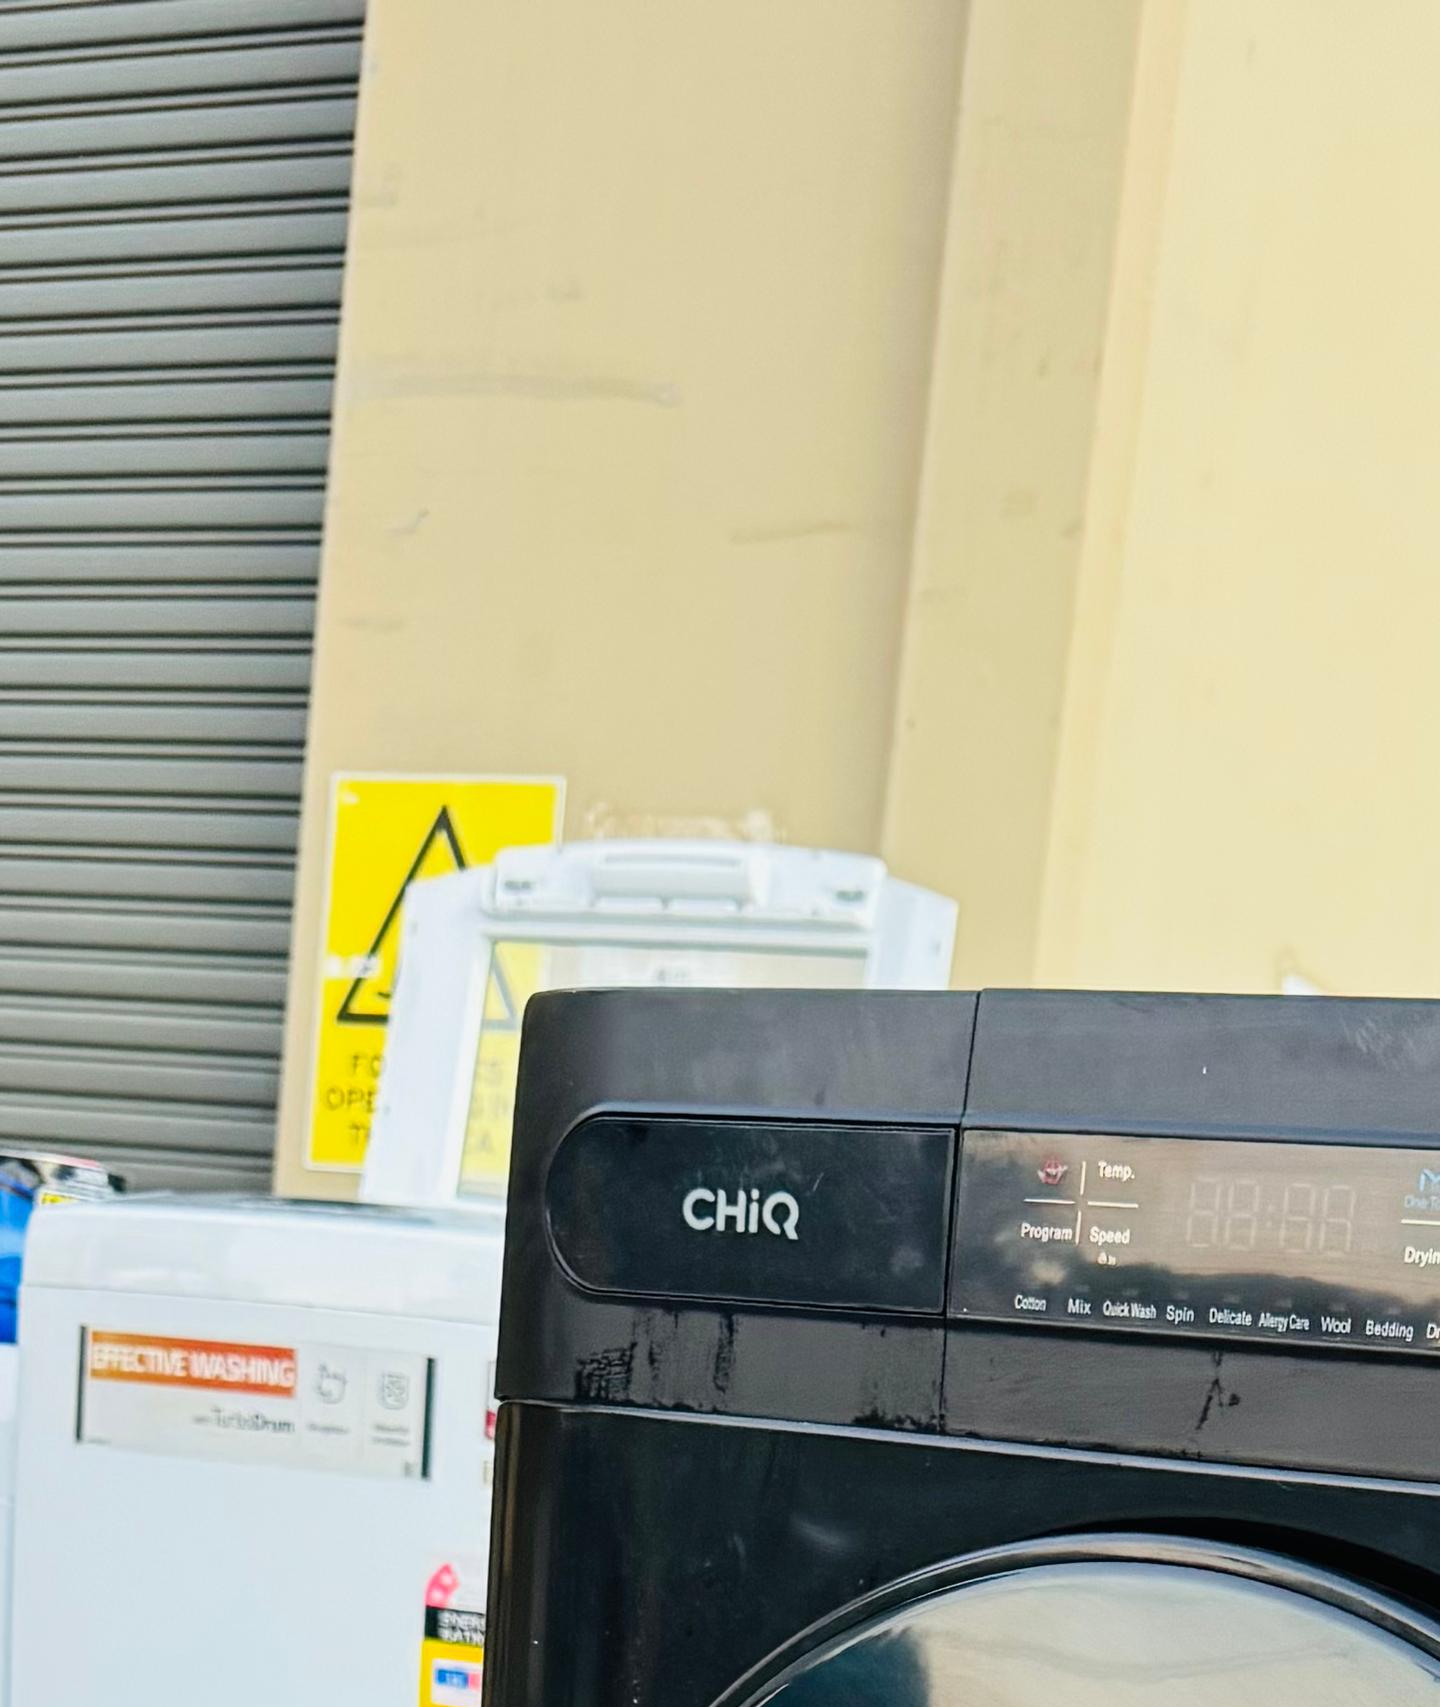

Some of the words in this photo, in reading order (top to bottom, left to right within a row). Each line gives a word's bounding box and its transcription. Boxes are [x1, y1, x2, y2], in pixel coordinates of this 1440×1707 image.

[1097, 1161, 1136, 1182] Temp.
[1020, 1222, 1073, 1243] Program
[1089, 1225, 1131, 1246] Speed
[1014, 1294, 1047, 1312] Cotton
[1067, 1297, 1092, 1316] Mix
[1103, 1300, 1130, 1319] Quick
[1130, 1302, 1157, 1320] Wash
[1166, 1305, 1195, 1325] Spin
[1209, 1307, 1252, 1328] Delicate
[1258, 1314, 1289, 1333] Allergy
[1289, 1315, 1310, 1332] Care
[1320, 1315, 1353, 1335] Wool
[1365, 1320, 1415, 1343] Bedding
[92, 1344, 188, 1377] EFFECTIVE
[189, 1353, 295, 1388] WASHING
